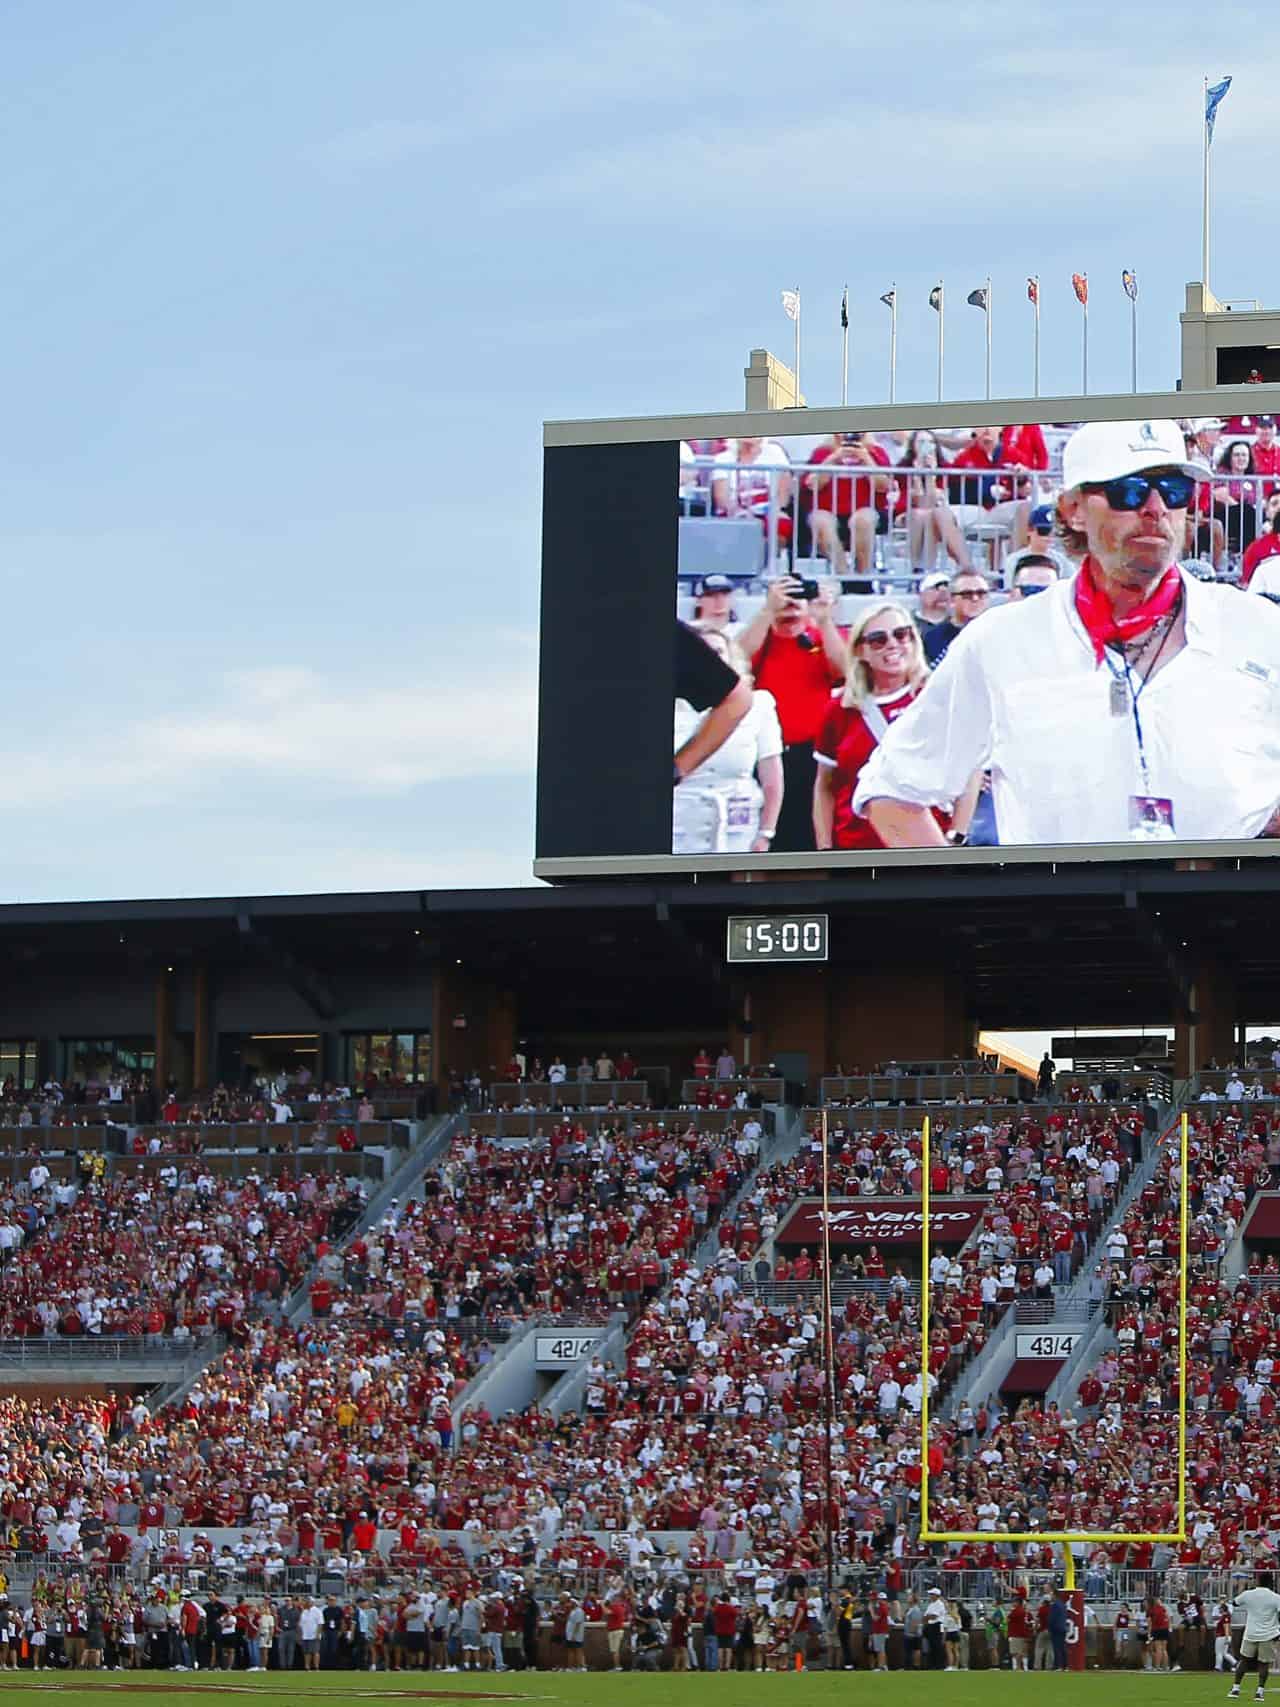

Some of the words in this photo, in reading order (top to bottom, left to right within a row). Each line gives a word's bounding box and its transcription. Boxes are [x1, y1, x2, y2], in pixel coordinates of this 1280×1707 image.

[746, 923, 820, 952] 15:00
[865, 1210, 971, 1222] Valero
[551, 1340, 600, 1358] 42/4
